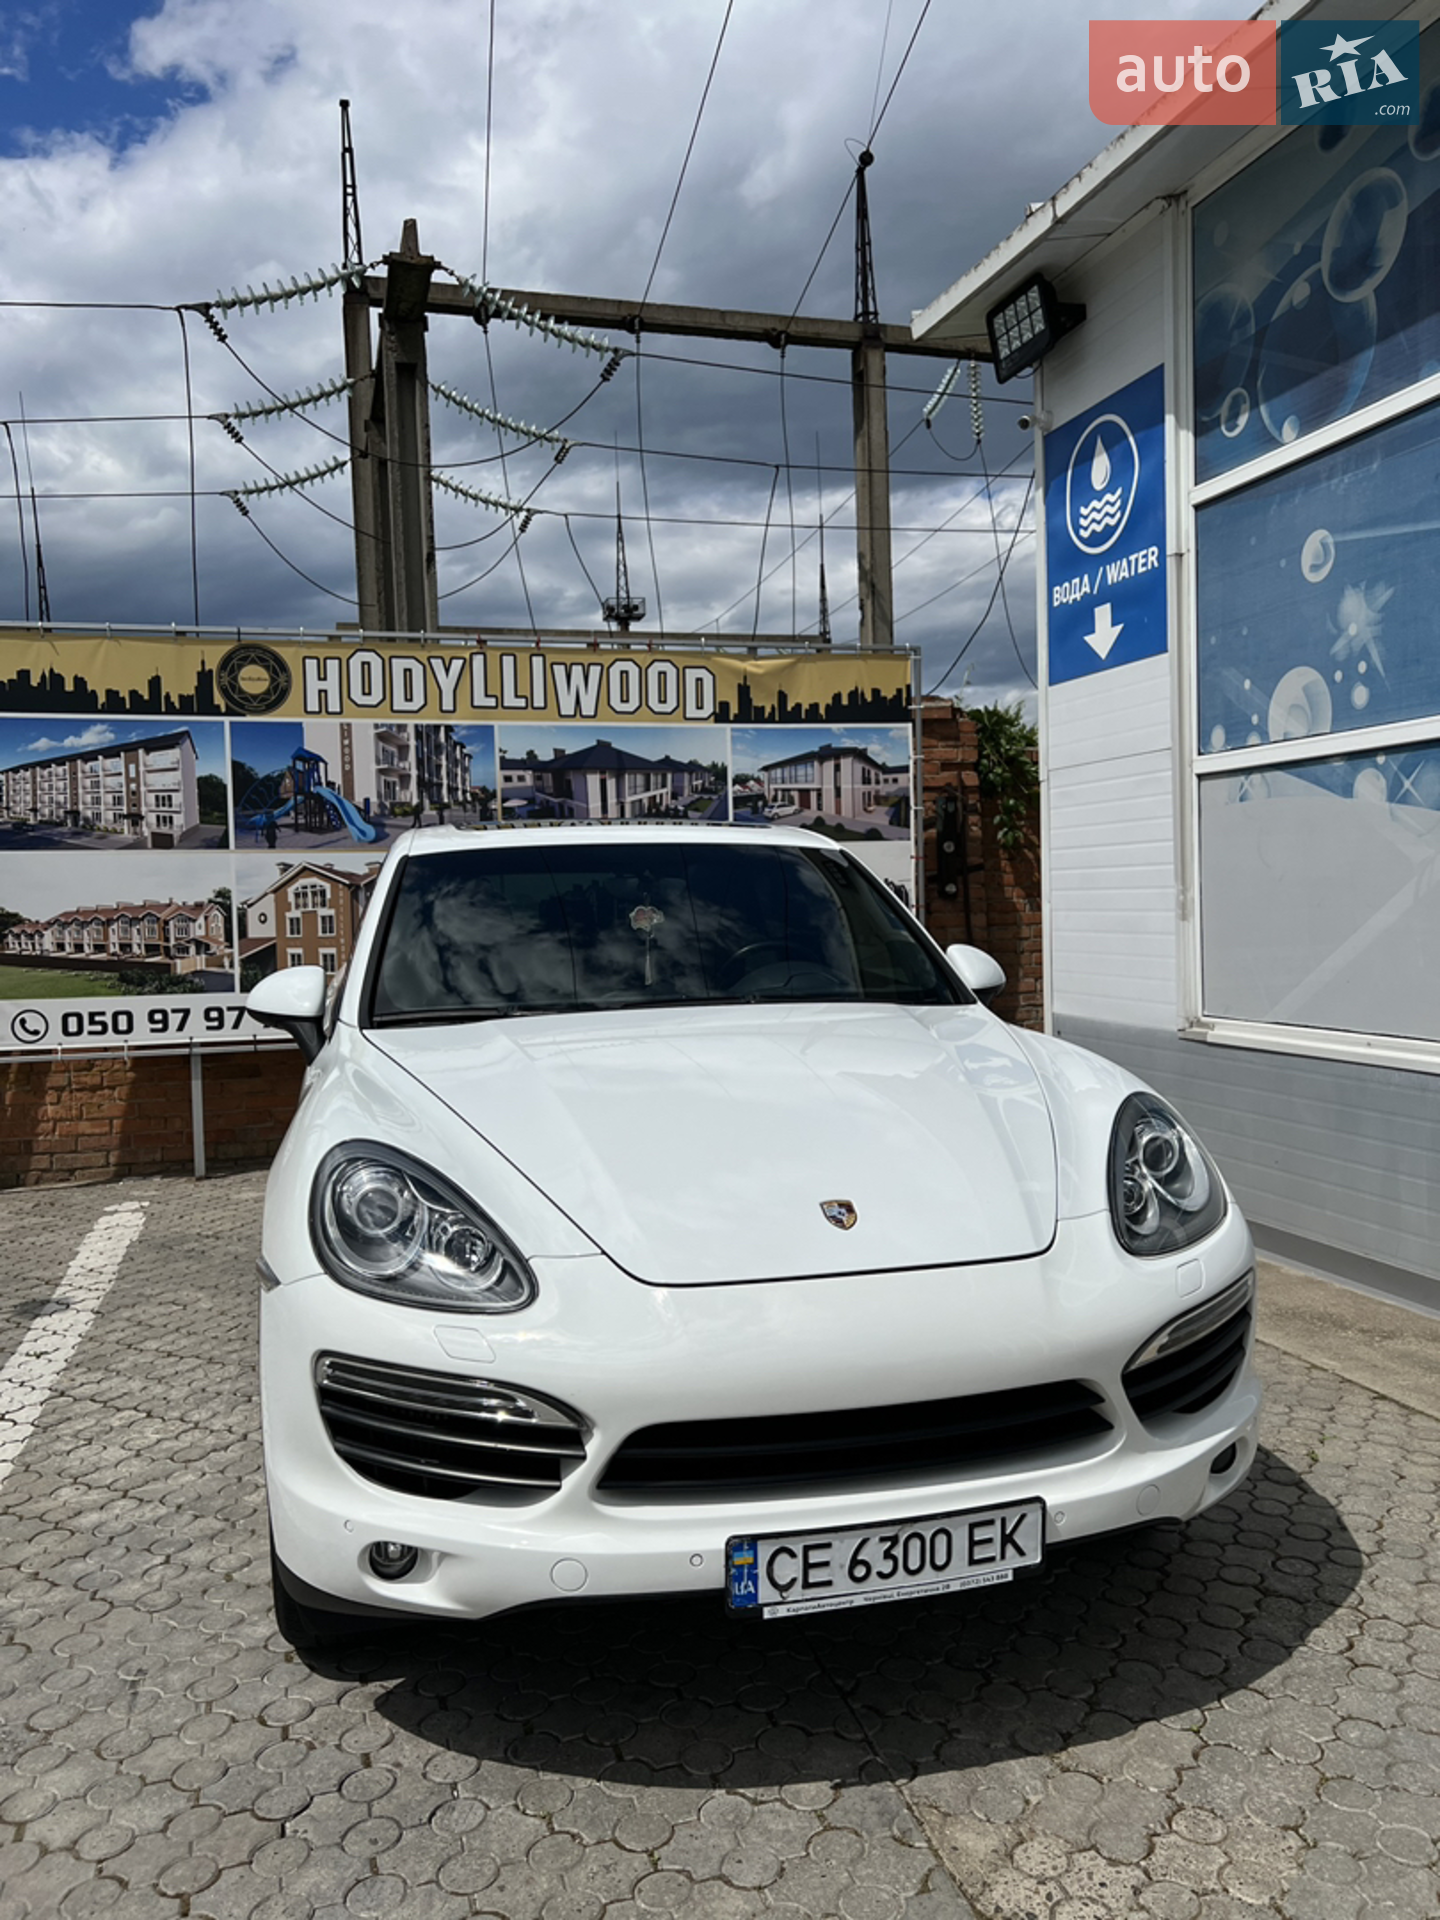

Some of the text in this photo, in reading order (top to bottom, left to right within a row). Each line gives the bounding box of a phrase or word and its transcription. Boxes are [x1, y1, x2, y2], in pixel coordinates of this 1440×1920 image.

[1053, 573, 1091, 607] ВОДА
[1106, 545, 1159, 586] WATER
[302, 648, 716, 720] HODYLLIWOOD
[61, 1006, 246, 1037] 050 97 97
[766, 1512, 1028, 1594] CE 6300 EK
